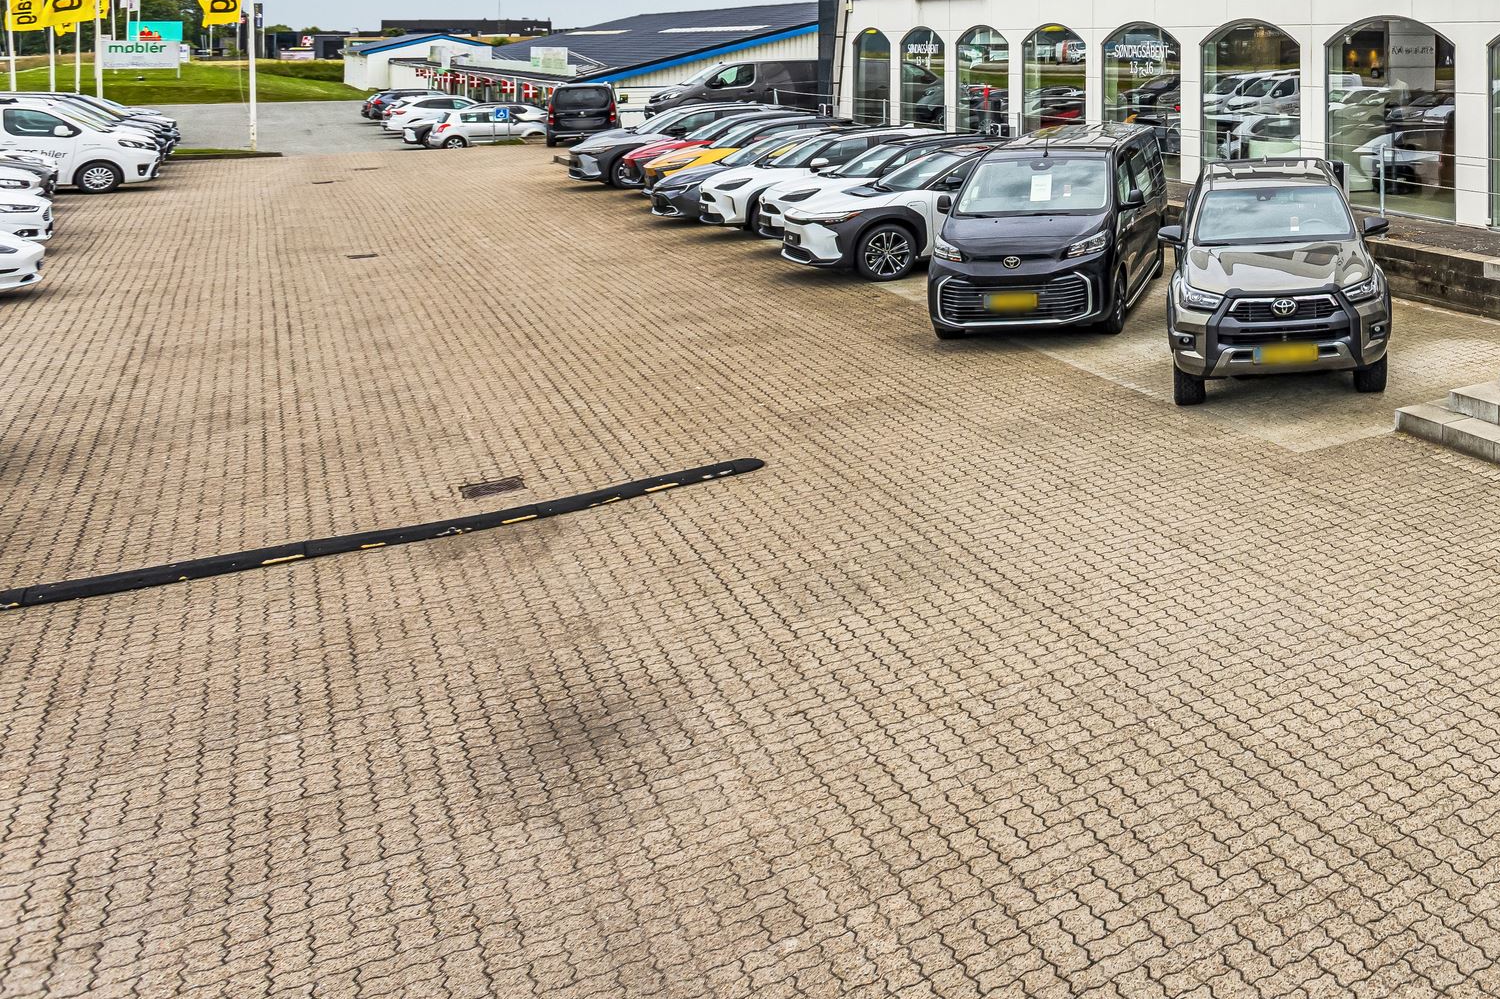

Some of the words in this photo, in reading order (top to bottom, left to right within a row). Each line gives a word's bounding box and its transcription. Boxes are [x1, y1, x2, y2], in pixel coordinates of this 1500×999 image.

[108, 42, 167, 54] møblér
[1114, 41, 1169, 59] SØNDAGSÅBENT
[1129, 61, 1138, 74] 13
[1145, 61, 1154, 74] 16
